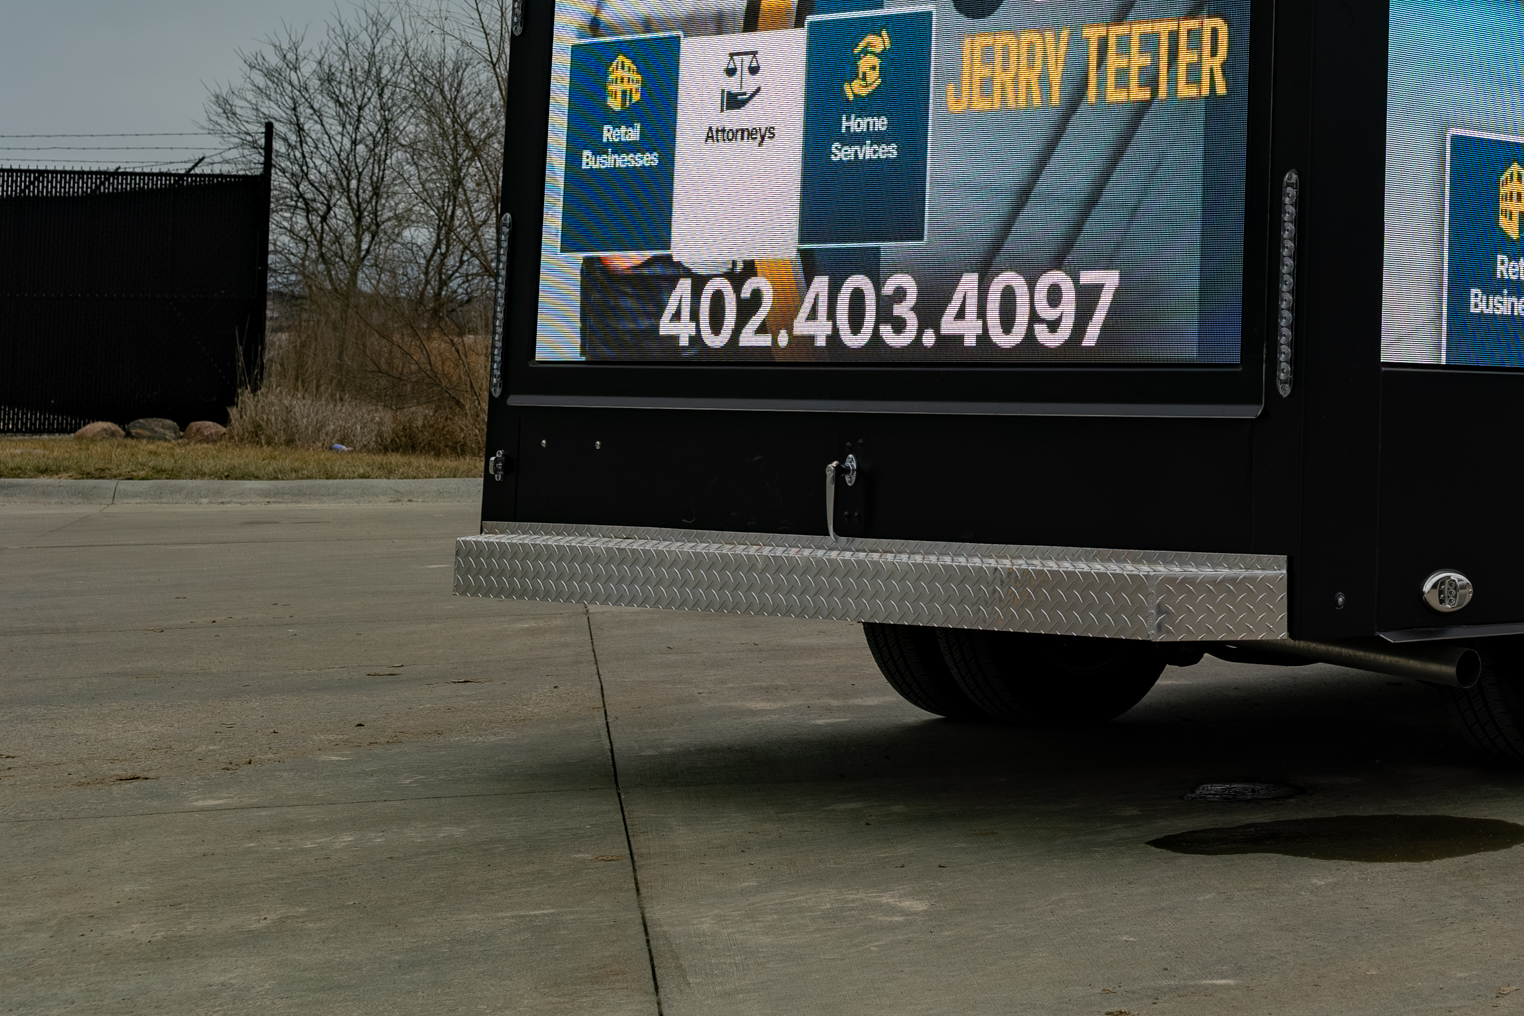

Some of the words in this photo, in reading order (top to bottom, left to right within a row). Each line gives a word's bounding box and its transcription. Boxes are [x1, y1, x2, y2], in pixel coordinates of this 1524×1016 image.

[946, 27, 1071, 114] JERRY
[1081, 17, 1229, 106] TEETER
[601, 122, 641, 144] Retail
[704, 122, 776, 148] Attorneys
[841, 112, 888, 134] Home
[581, 147, 660, 171] Businesses
[830, 138, 898, 163] Services
[659, 270, 1120, 350] 402.403.4097
